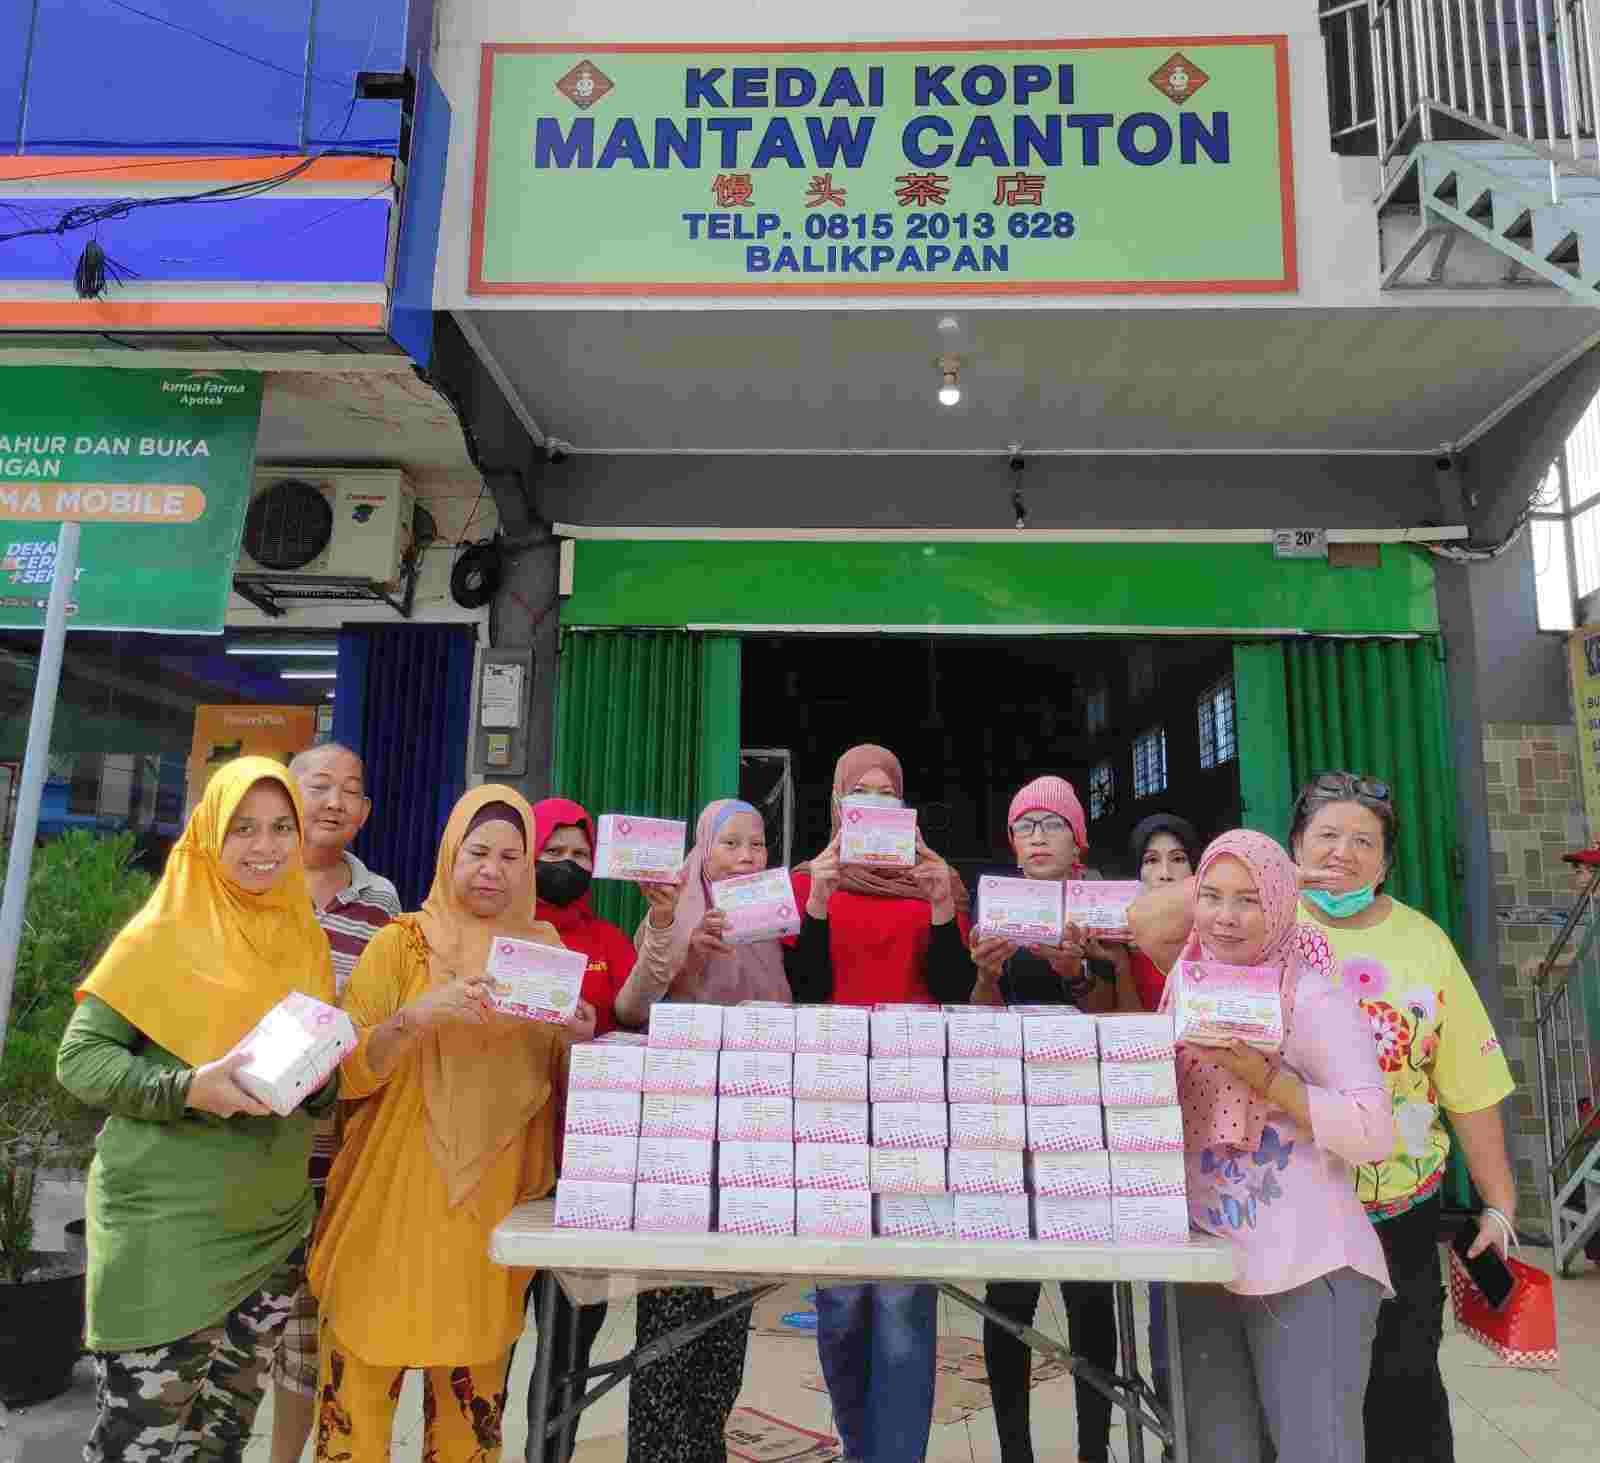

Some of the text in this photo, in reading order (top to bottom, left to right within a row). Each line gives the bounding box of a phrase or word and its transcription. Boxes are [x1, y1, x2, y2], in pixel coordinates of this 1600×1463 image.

[685, 63, 1074, 109] KEDAI KOPI
[534, 111, 1231, 170] MANTAW CANTON
[681, 211, 1075, 241] TELP. 0815 2013 628
[746, 243, 1009, 273] BALIKPAPAN
[161, 380, 246, 393] kimia farma
[73, 436, 130, 456] DAN
[138, 437, 210, 457] BUKA
[55, 487, 187, 515] MOBILE
